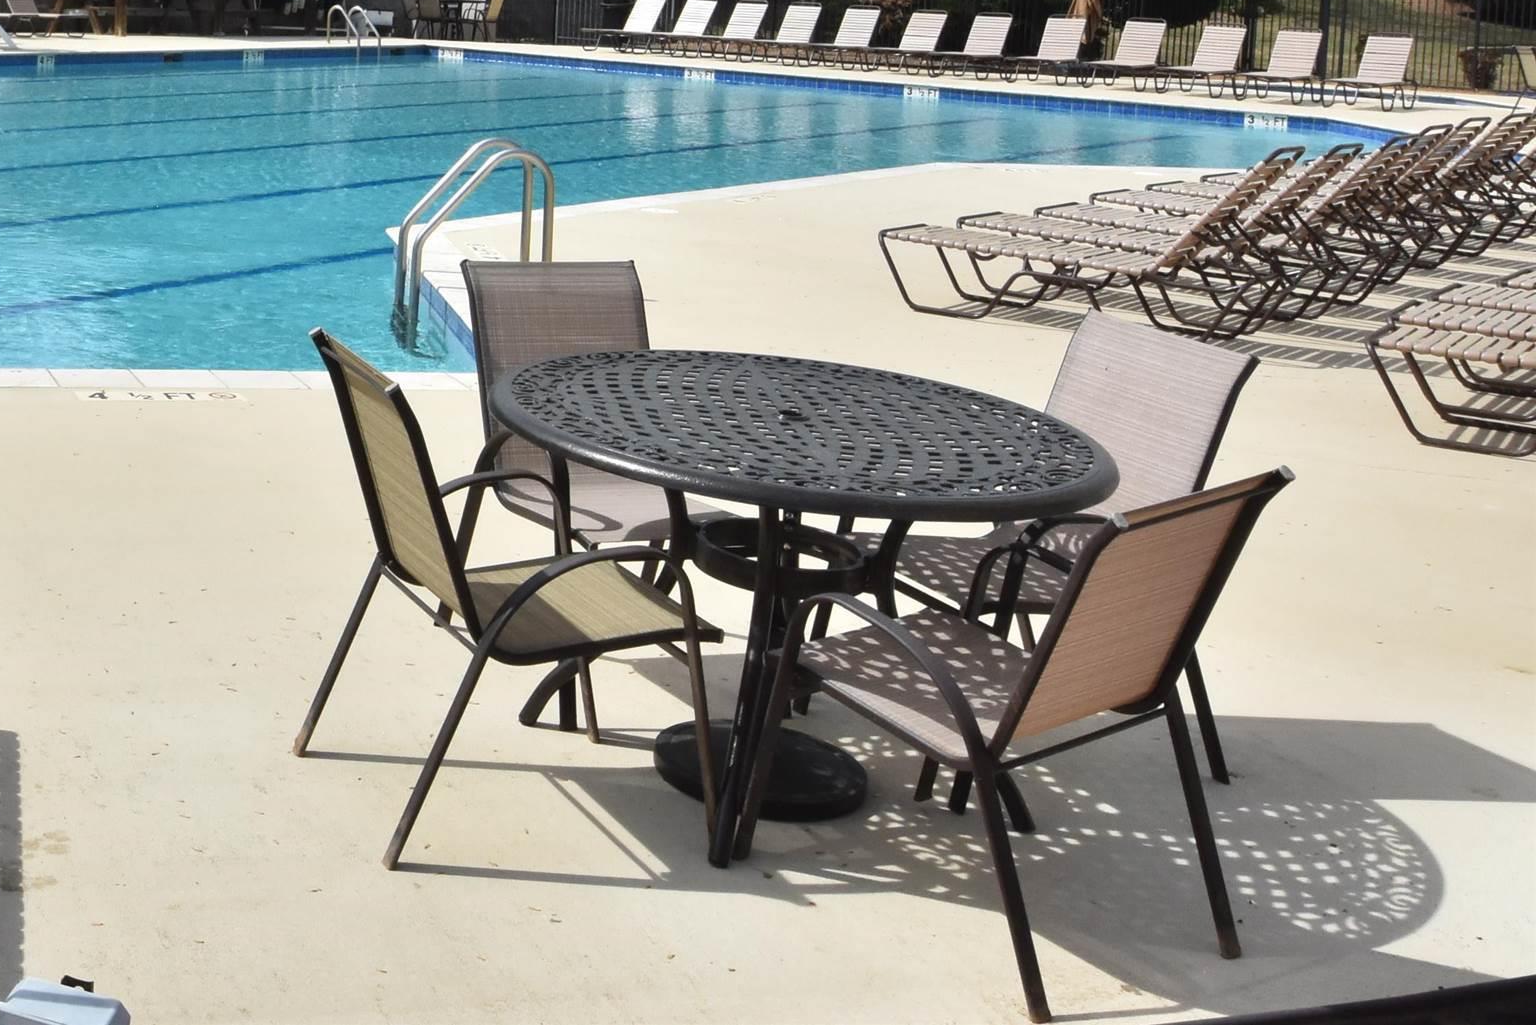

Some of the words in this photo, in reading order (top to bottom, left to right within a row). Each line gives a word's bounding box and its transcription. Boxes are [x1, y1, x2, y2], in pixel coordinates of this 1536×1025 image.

[907, 85, 913, 96] 3
[928, 88, 937, 98] FT
[1248, 114, 1255, 125] 3
[1274, 116, 1287, 127] FT
[88, 389, 109, 400] 4
[163, 392, 196, 400] FT
